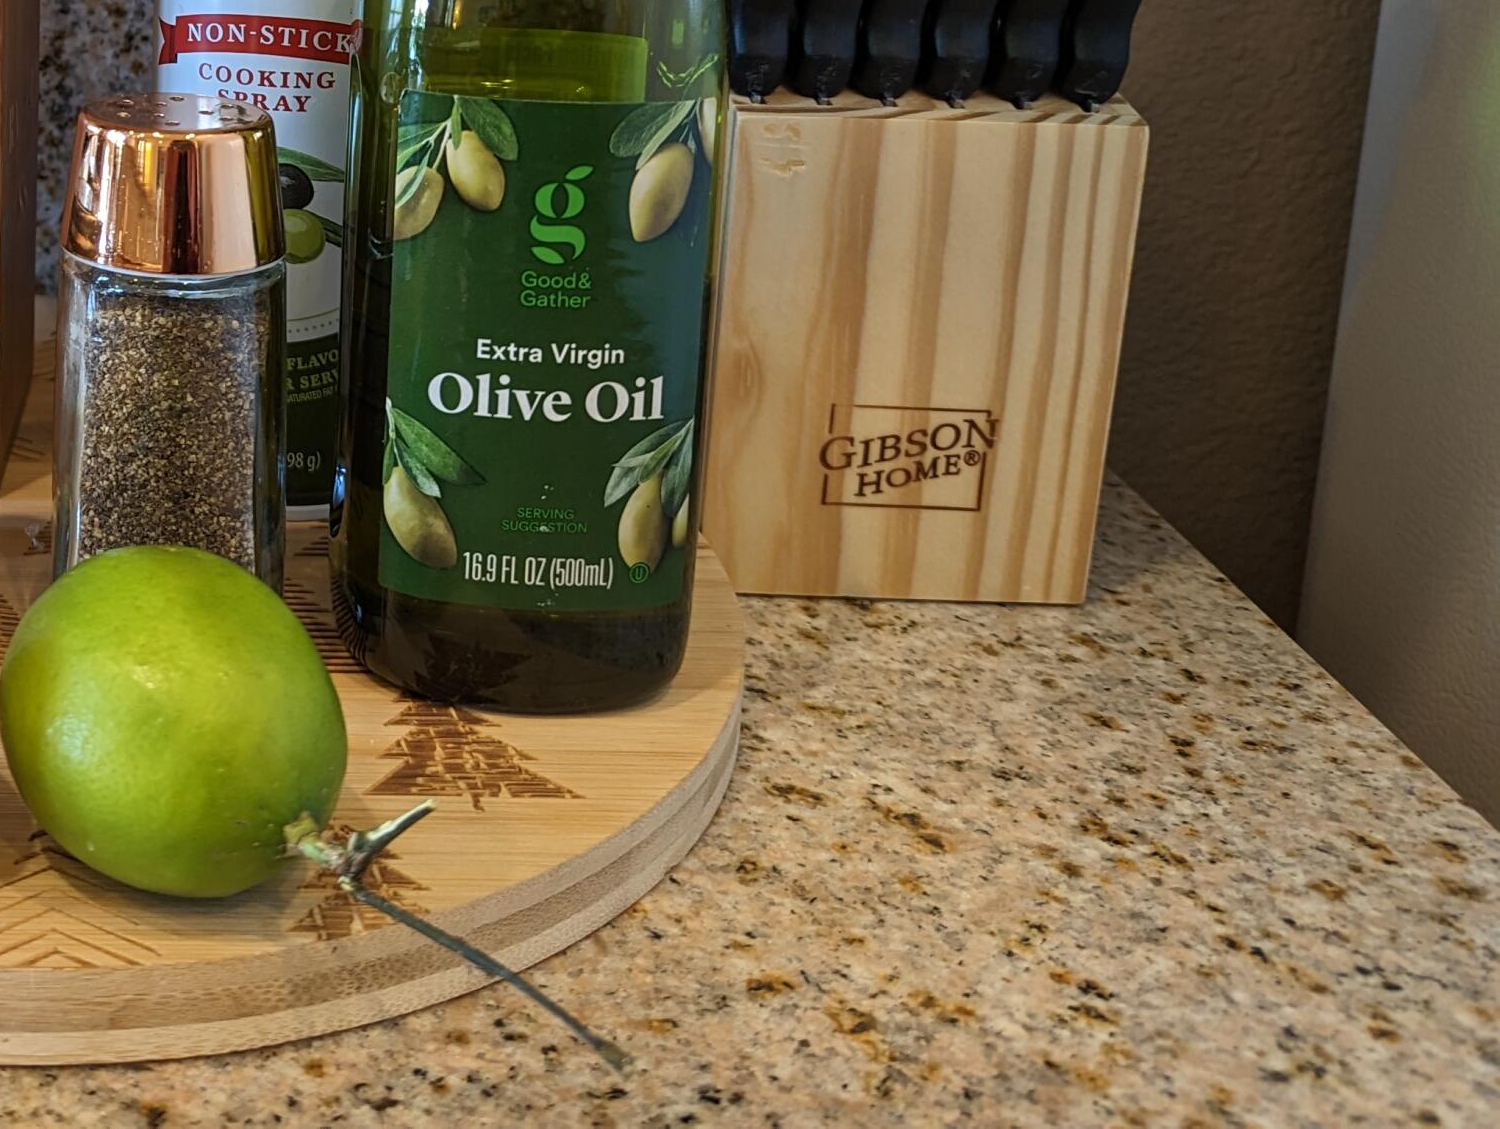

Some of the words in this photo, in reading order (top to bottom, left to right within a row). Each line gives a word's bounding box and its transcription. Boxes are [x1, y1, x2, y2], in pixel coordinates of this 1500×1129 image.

[187, 22, 351, 53] NON-STICK
[199, 63, 335, 89] COOKING
[520, 291, 591, 308] Gather
[286, 349, 339, 371] FLAVO
[476, 339, 543, 363] Extra
[551, 343, 625, 369] Virgin
[286, 389, 322, 404] ATURATED
[427, 372, 572, 422] Olive
[585, 376, 665, 423] Oil
[819, 419, 999, 470] GIBSON
[286, 452, 304, 468] 98
[501, 517, 588, 534] SUGGESTION
[517, 506, 575, 521] SERVING
[462, 551, 495, 582] 16.9
[500, 556, 519, 584] FL
[524, 557, 547, 586] OZ
[550, 557, 614, 590] (500mL)
